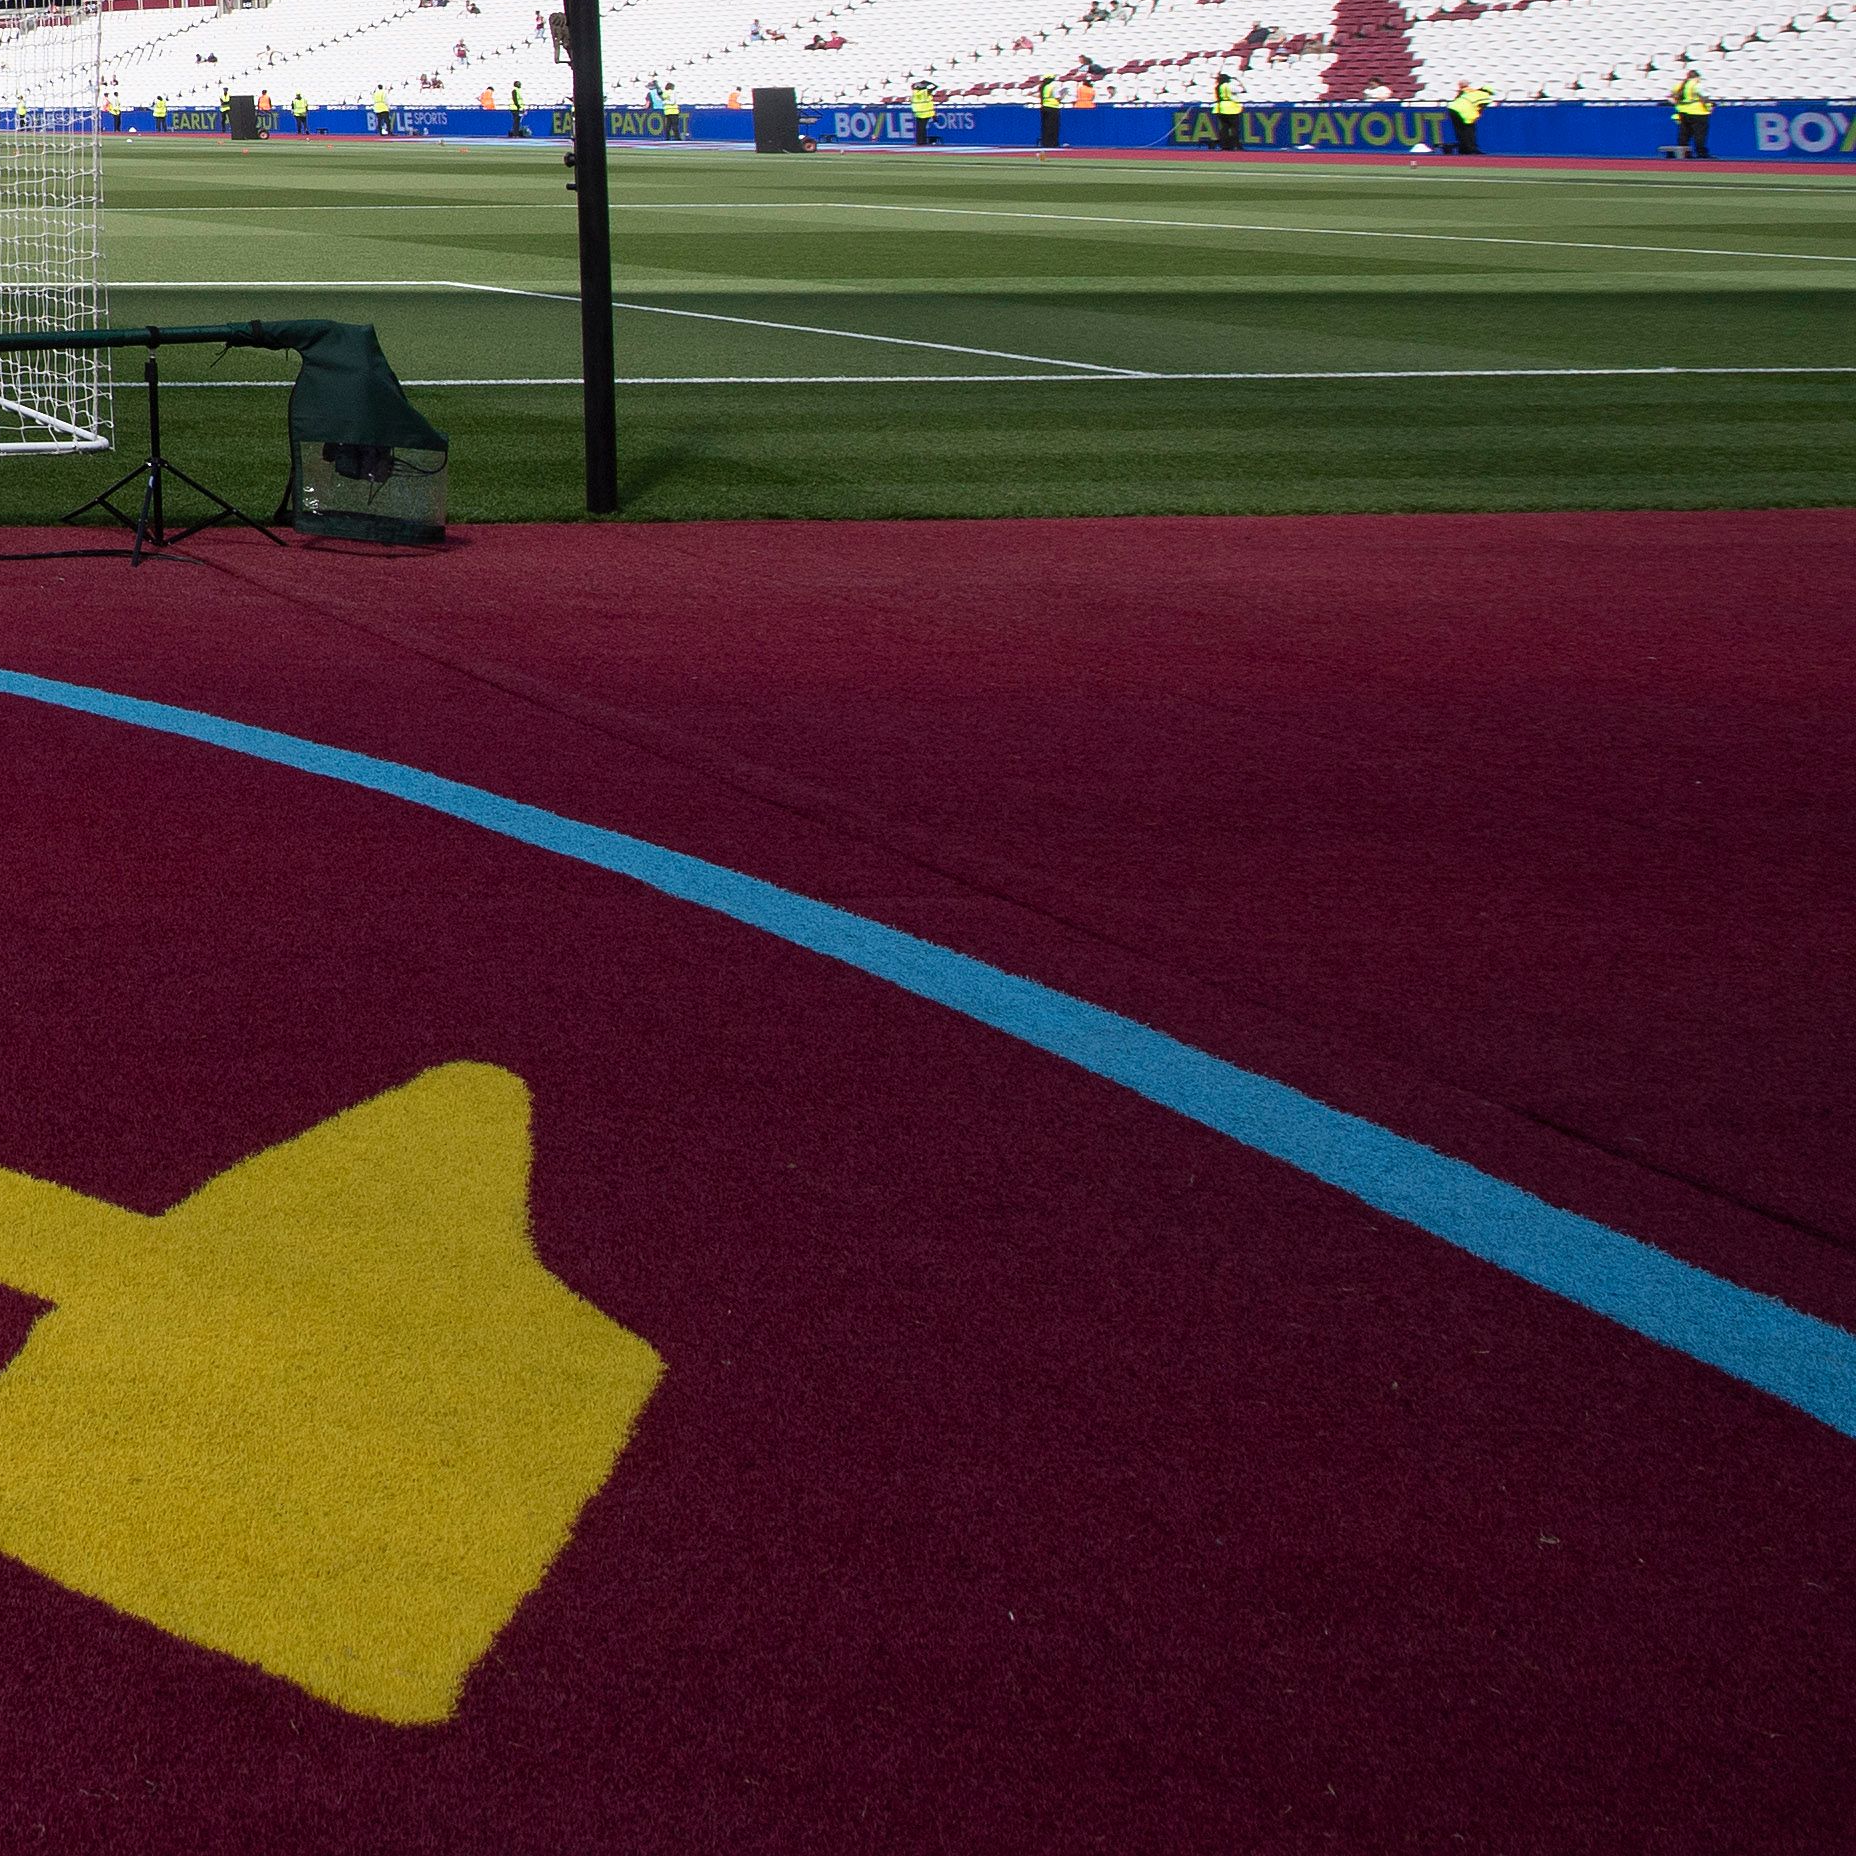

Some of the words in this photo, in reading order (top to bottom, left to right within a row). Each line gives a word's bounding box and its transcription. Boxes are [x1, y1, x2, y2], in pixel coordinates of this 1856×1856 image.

[172, 111, 217, 131] EARLY
[414, 110, 448, 126] SPORTS
[610, 111, 690, 135] PAYOT
[835, 111, 915, 139] BOYLE
[1173, 111, 1282, 143] EALY
[1291, 111, 1447, 146] PAYOUT
